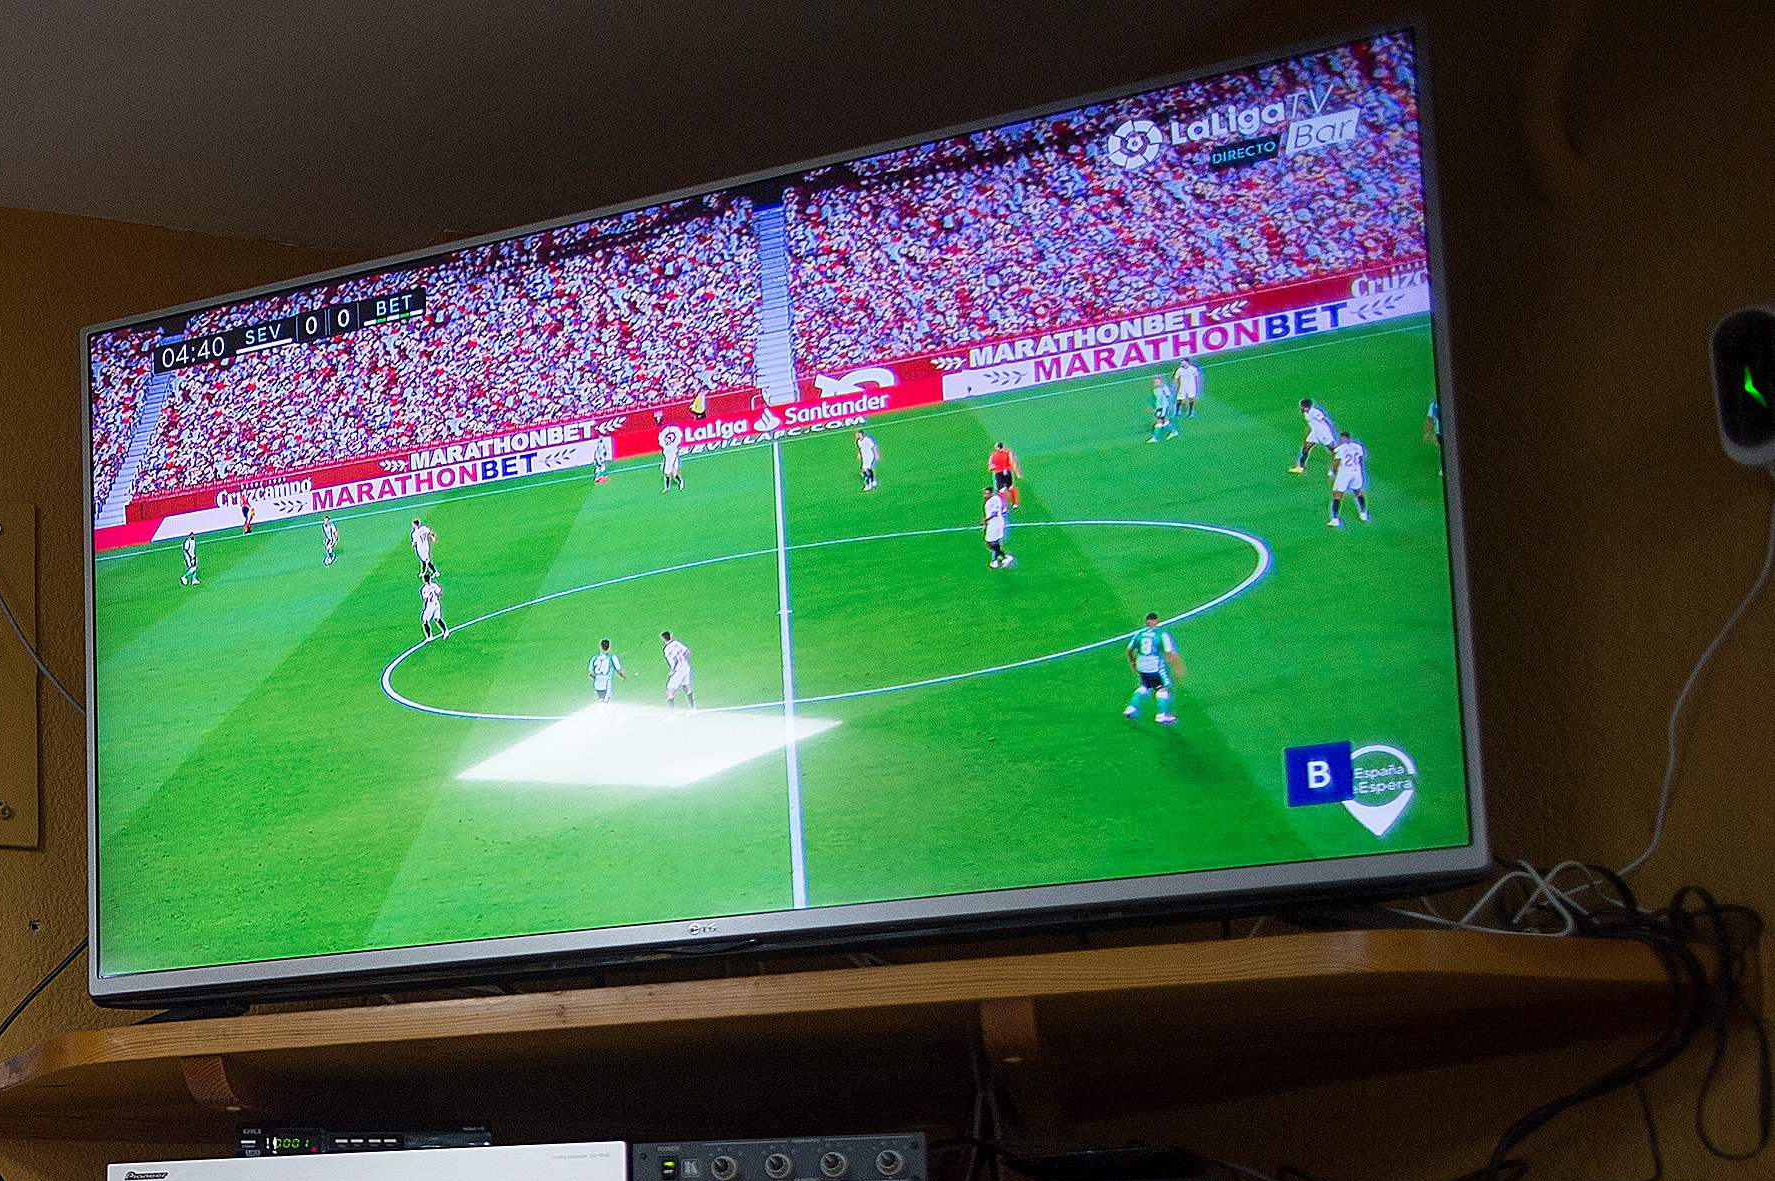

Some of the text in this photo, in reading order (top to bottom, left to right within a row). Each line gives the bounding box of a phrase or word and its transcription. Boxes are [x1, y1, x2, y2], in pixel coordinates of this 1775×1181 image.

[1171, 84, 1333, 145] LaLiga TV
[1295, 119, 1352, 149] Bar
[1212, 141, 1276, 165] DIRECTO
[162, 294, 412, 368] 04:40 SEV 0 0 BET
[969, 305, 1207, 368] MARATHONBET
[1034, 302, 1348, 383] MARATHONBET
[685, 392, 889, 443] LaLiga Santander
[410, 419, 596, 470] MARATHONBET
[216, 477, 312, 508] Cruzcampo
[312, 453, 538, 511] MARATHONBET
[1307, 760, 1331, 789] B
[125, 1171, 168, 1181] Pioneer
